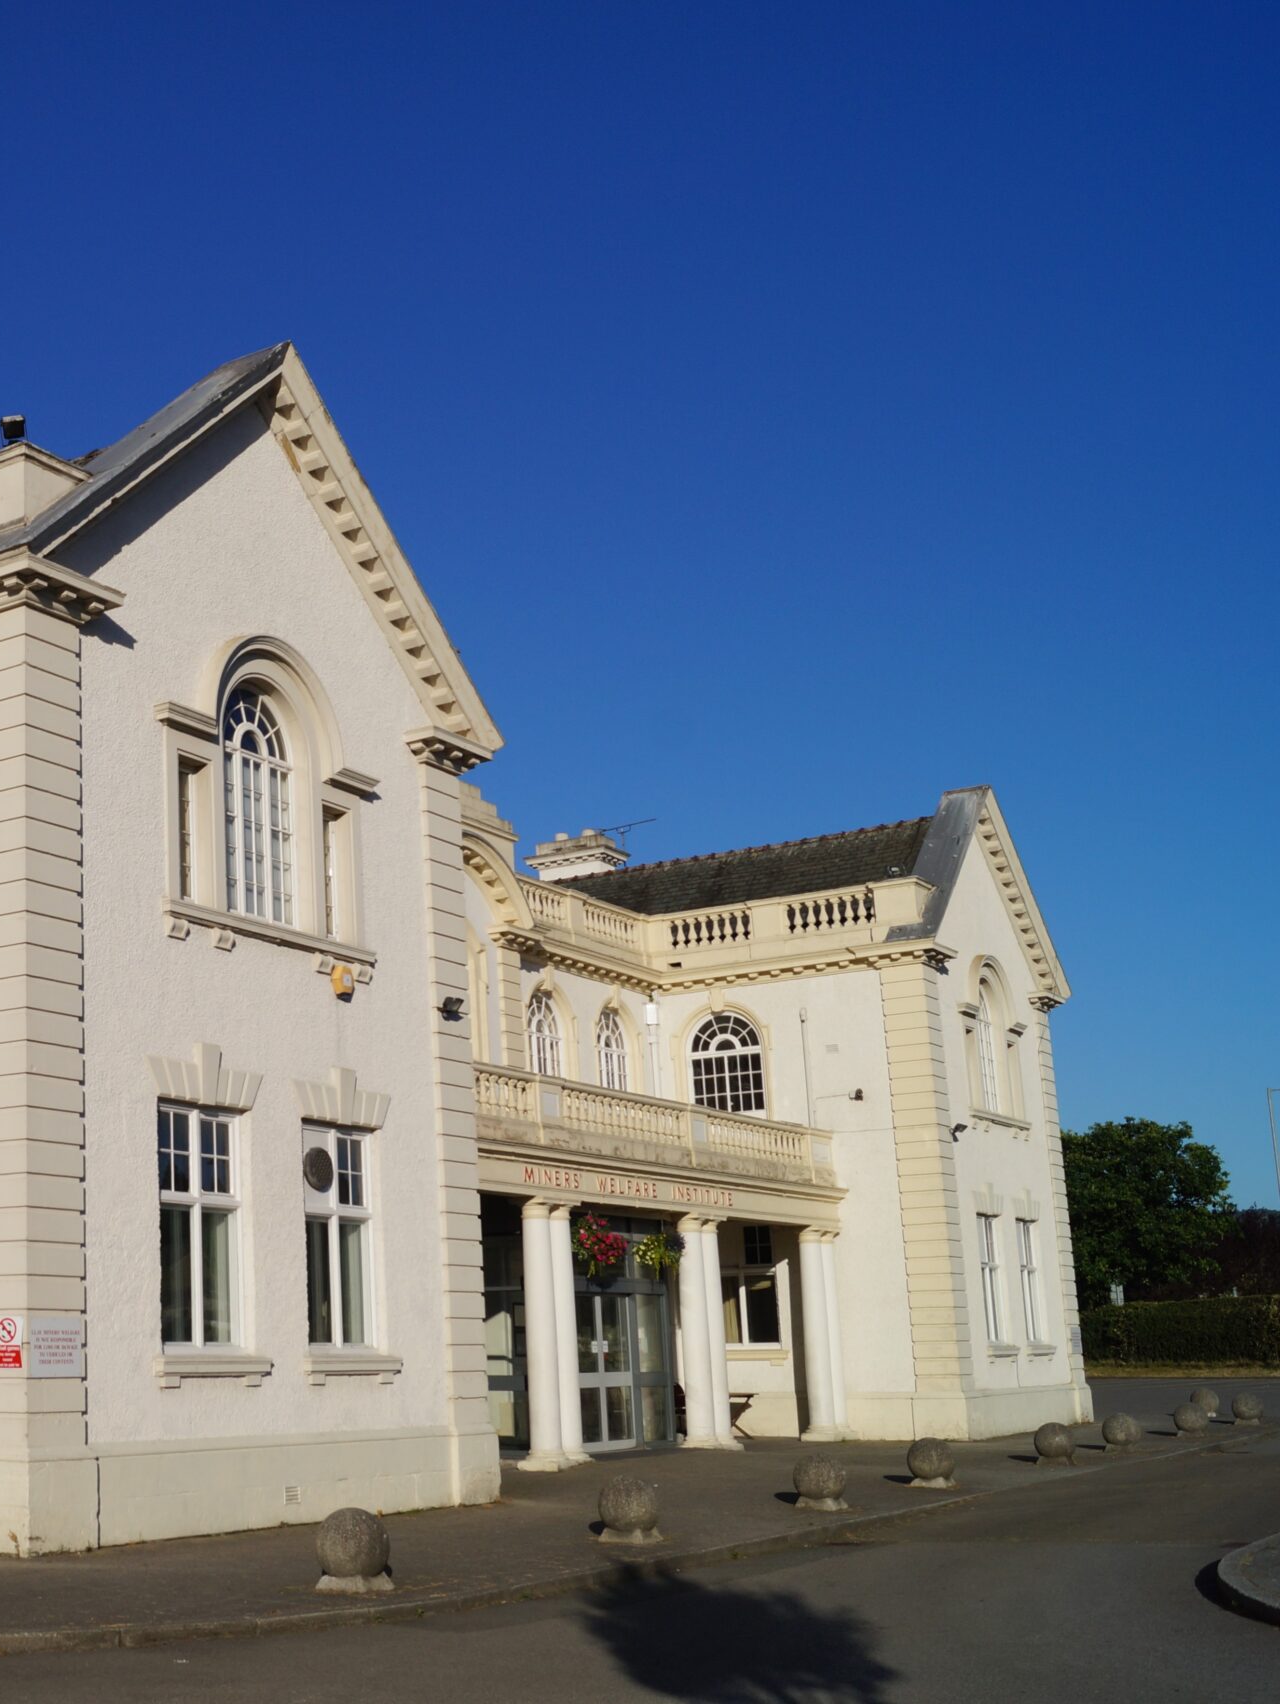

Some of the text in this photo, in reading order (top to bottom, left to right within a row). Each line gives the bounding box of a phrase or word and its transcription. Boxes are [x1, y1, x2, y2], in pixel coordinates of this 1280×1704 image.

[524, 1166, 734, 1207] MINERS' WELFARE INSTITUTE
